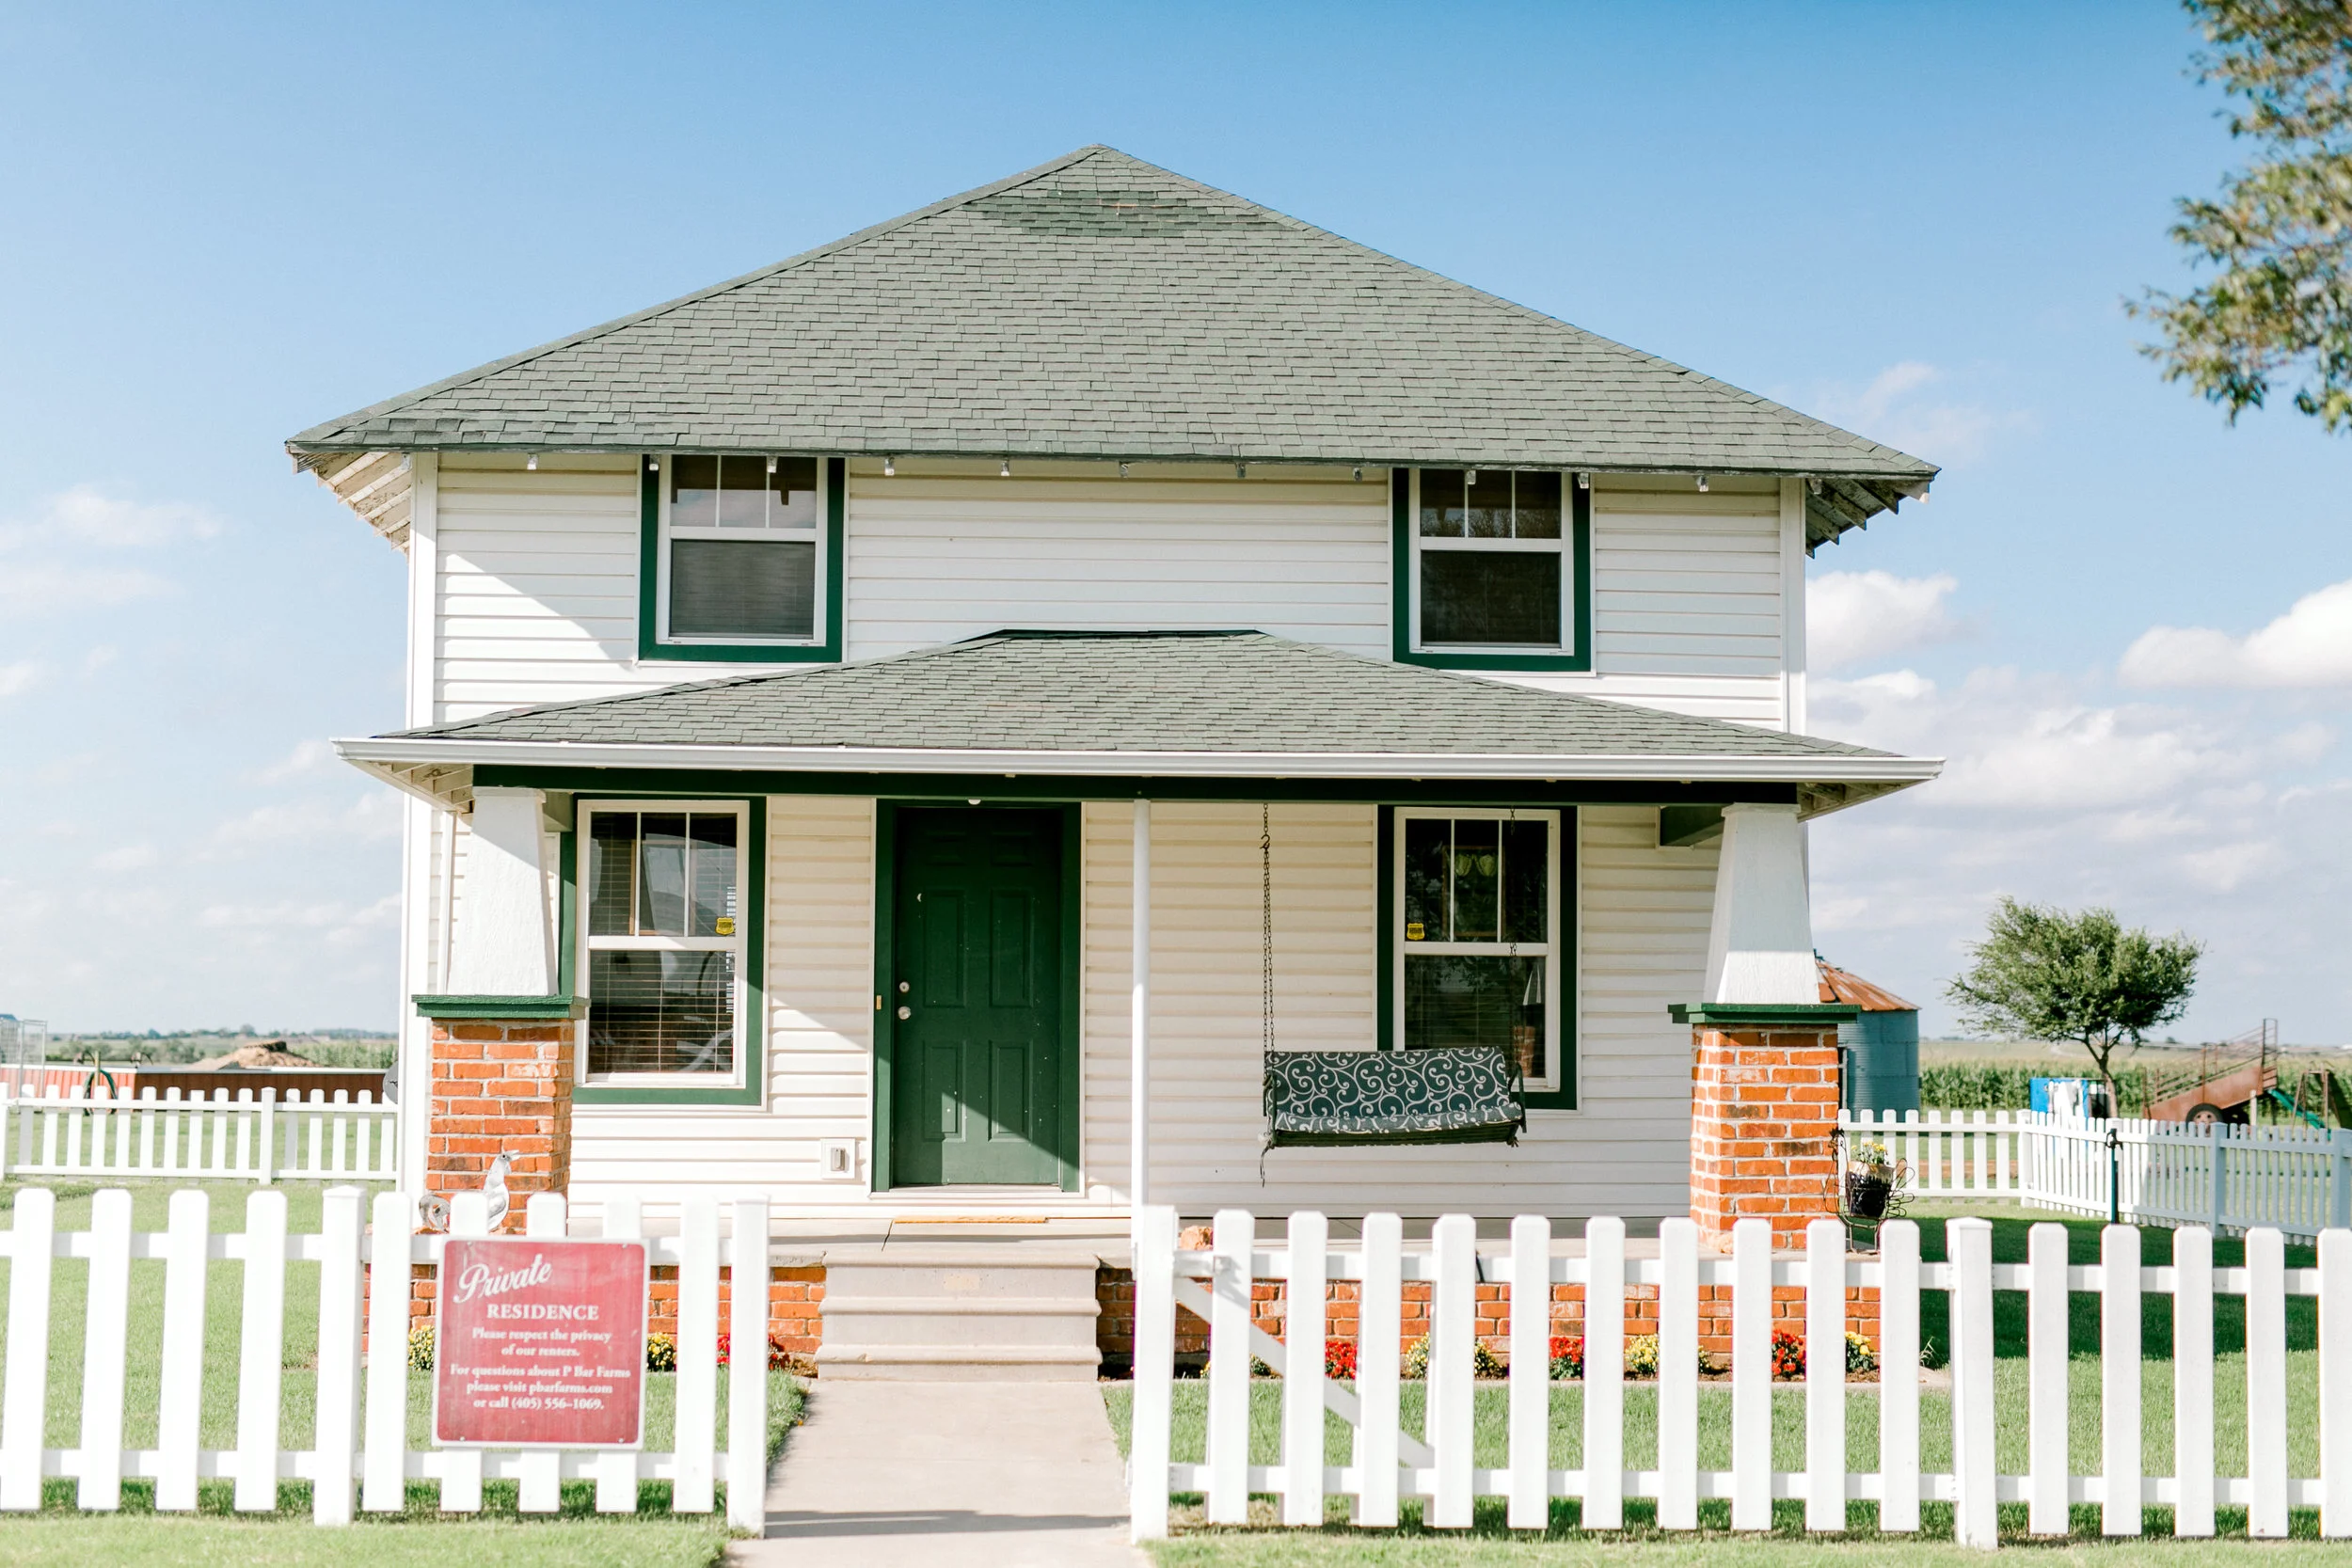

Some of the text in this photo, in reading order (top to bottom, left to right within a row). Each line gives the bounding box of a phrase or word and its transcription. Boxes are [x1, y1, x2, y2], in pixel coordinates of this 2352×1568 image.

[453, 1253, 552, 1304] Private
[486, 1304, 599, 1320] RESIDENCE
[472, 1327, 612, 1344] Please respect the privacy
[501, 1343, 516, 1355] of
[539, 1348, 580, 1356] renters.
[450, 1364, 631, 1378] For questions about P Bar Farms
[467, 1380, 613, 1396] please visit pbarfarms.com
[473, 1400, 487, 1408] or
[488, 1396, 509, 1408] call
[511, 1397, 542, 1410] (405)
